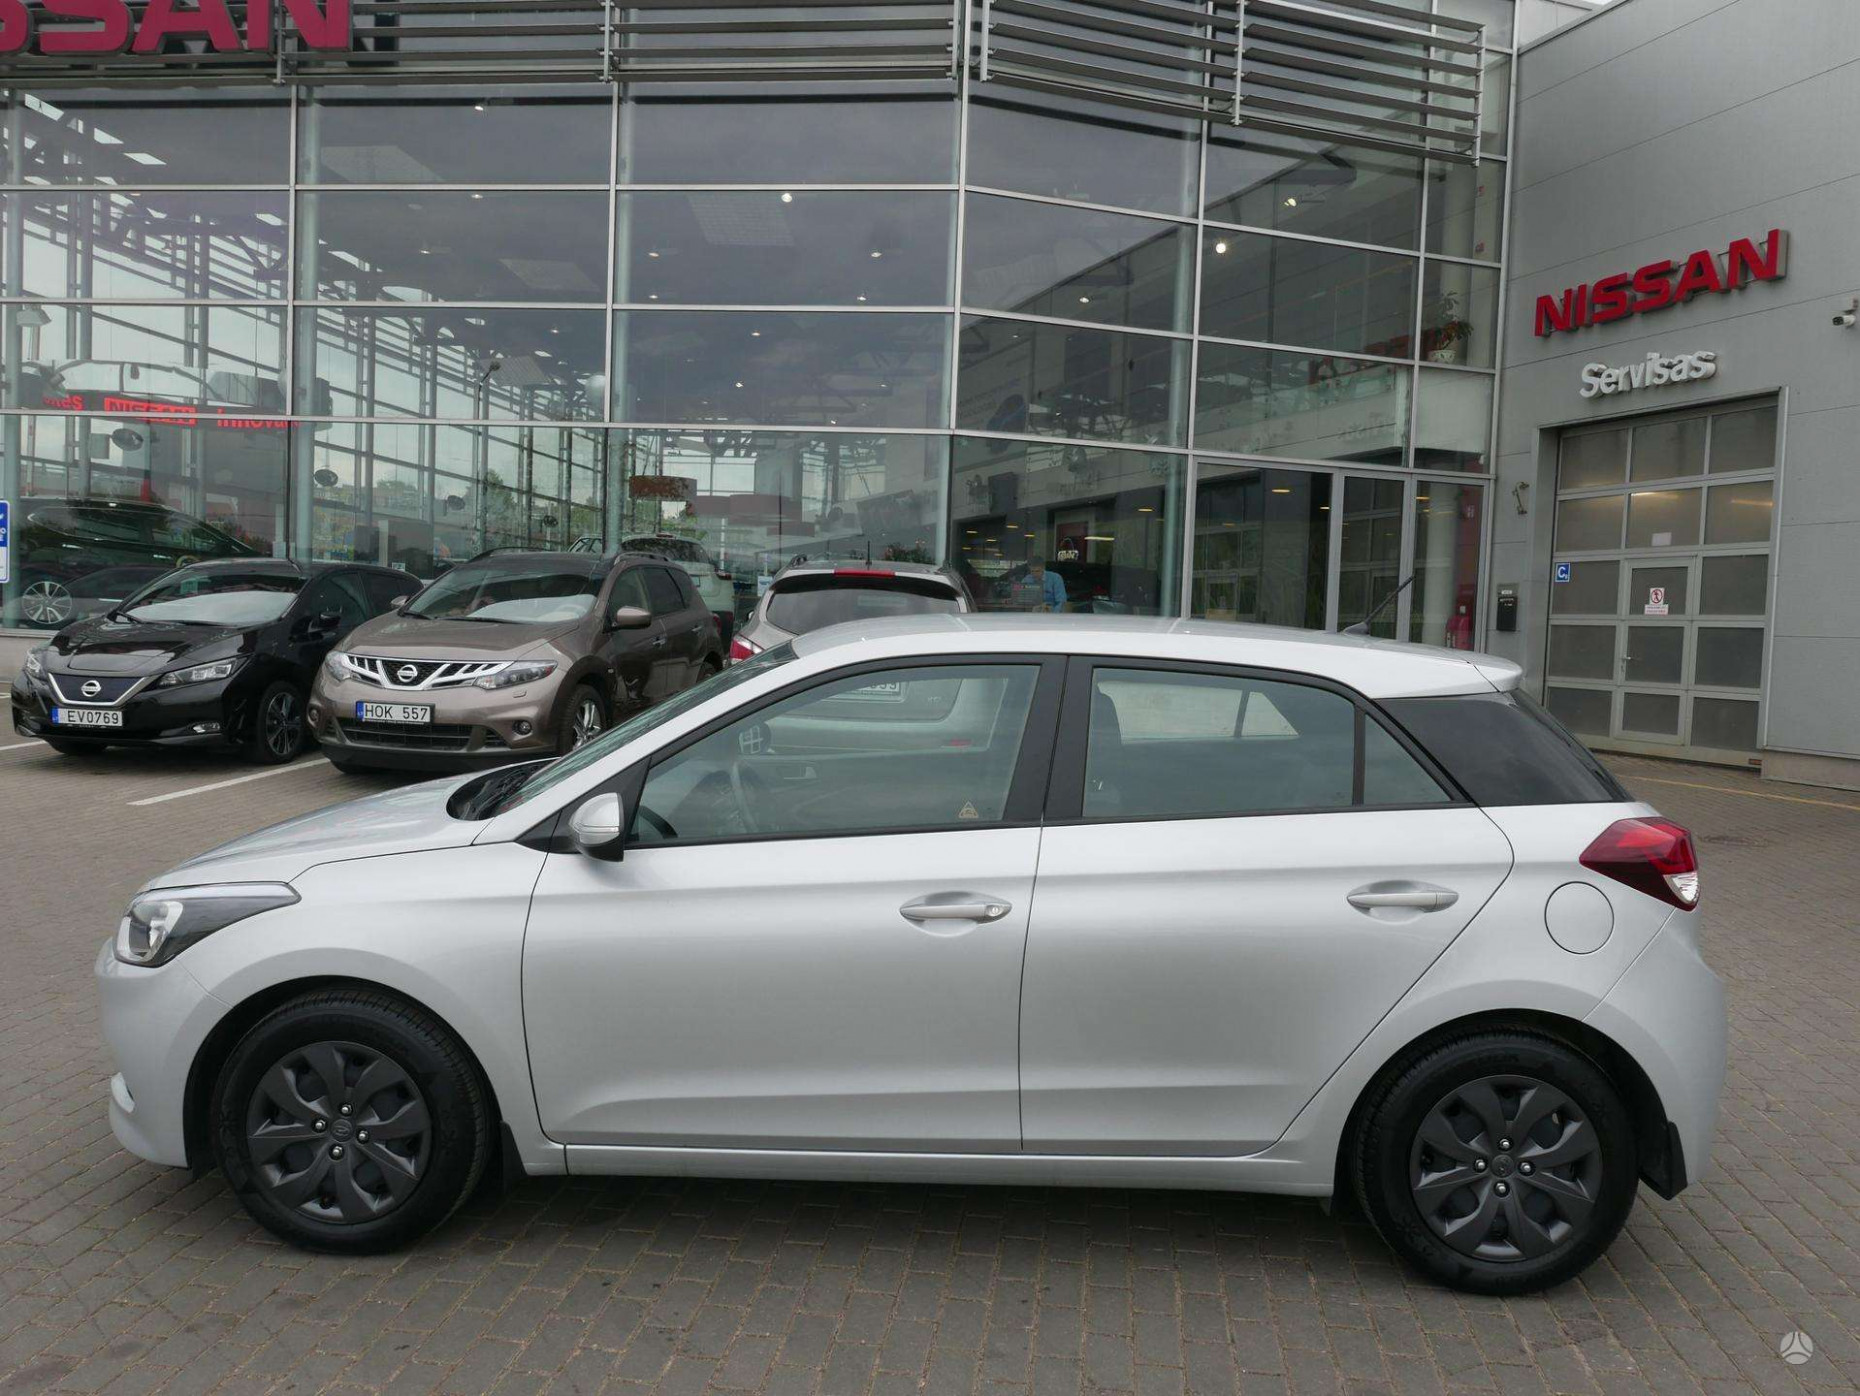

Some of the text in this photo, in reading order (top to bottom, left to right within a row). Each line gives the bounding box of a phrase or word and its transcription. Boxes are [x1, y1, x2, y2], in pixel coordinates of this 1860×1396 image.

[0, 0, 353, 53] SAN
[1534, 228, 1785, 337] NISSAN
[1579, 350, 1717, 399] Servisas
[67, 710, 119, 725] EV0769
[365, 704, 428, 721] HOK 557
